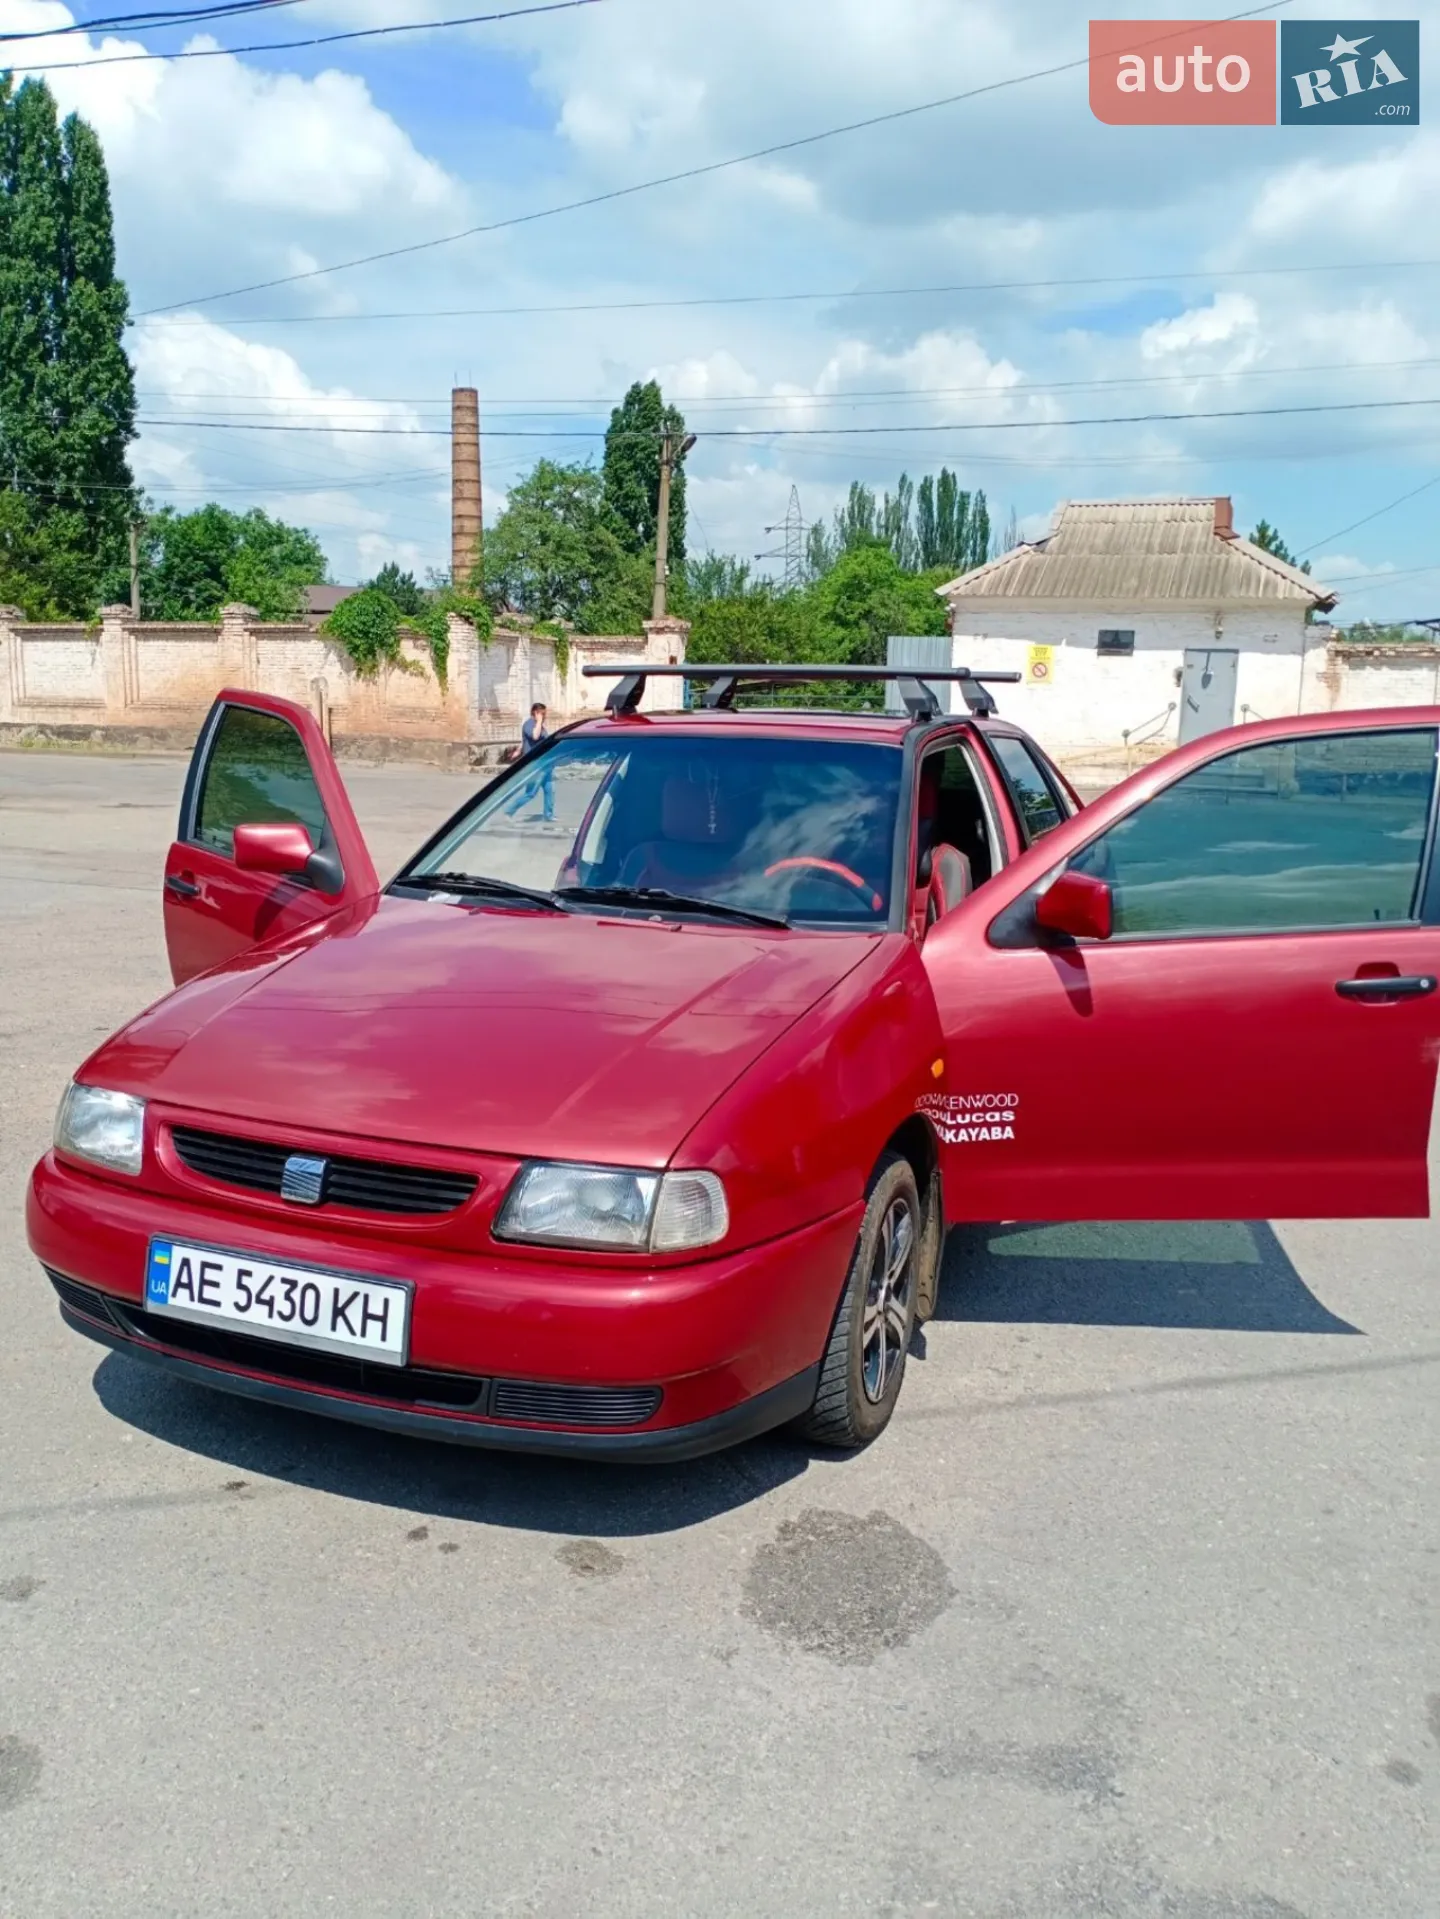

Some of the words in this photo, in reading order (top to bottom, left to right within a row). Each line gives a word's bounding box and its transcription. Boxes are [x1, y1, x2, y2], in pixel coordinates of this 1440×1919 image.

[946, 1093, 1019, 1110] ENWOOD
[946, 1110, 1016, 1125] Lucas
[945, 1126, 1015, 1144] KAYABA
[151, 1279, 167, 1296] UA
[171, 1256, 223, 1308] AE
[233, 1268, 321, 1327] 5430
[330, 1287, 389, 1342] KH
